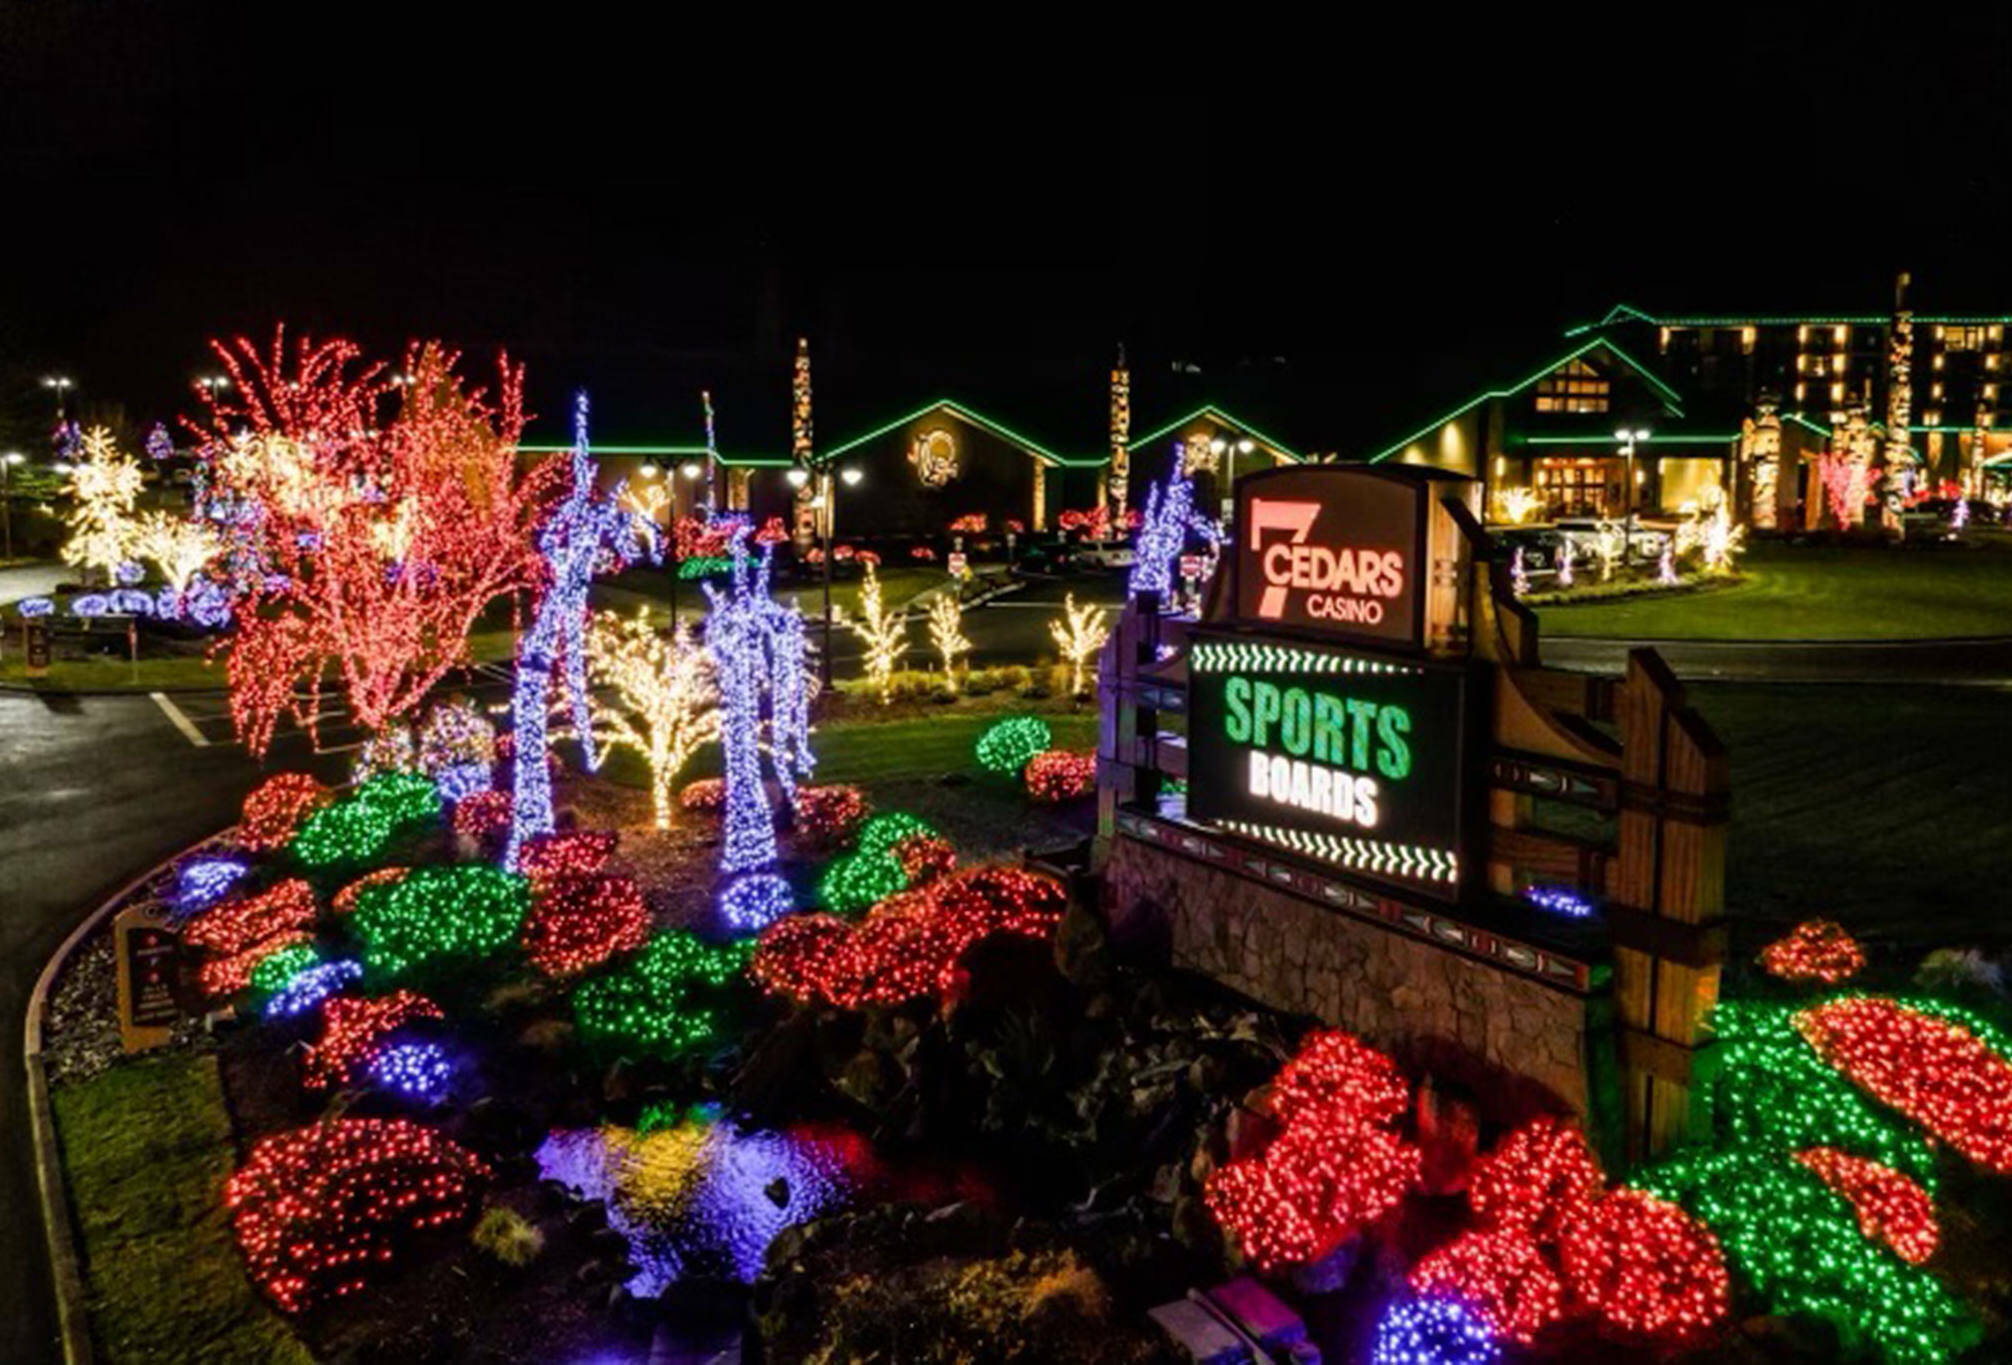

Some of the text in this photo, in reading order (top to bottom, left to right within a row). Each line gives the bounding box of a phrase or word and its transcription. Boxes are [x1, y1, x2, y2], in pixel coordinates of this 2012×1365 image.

[1251, 498, 1321, 618] 7
[1264, 544, 1404, 598] CEDARS
[1307, 594, 1383, 625] CASINO
[1225, 676, 1412, 780] SPORTS
[1249, 751, 1379, 828] BOARDS
